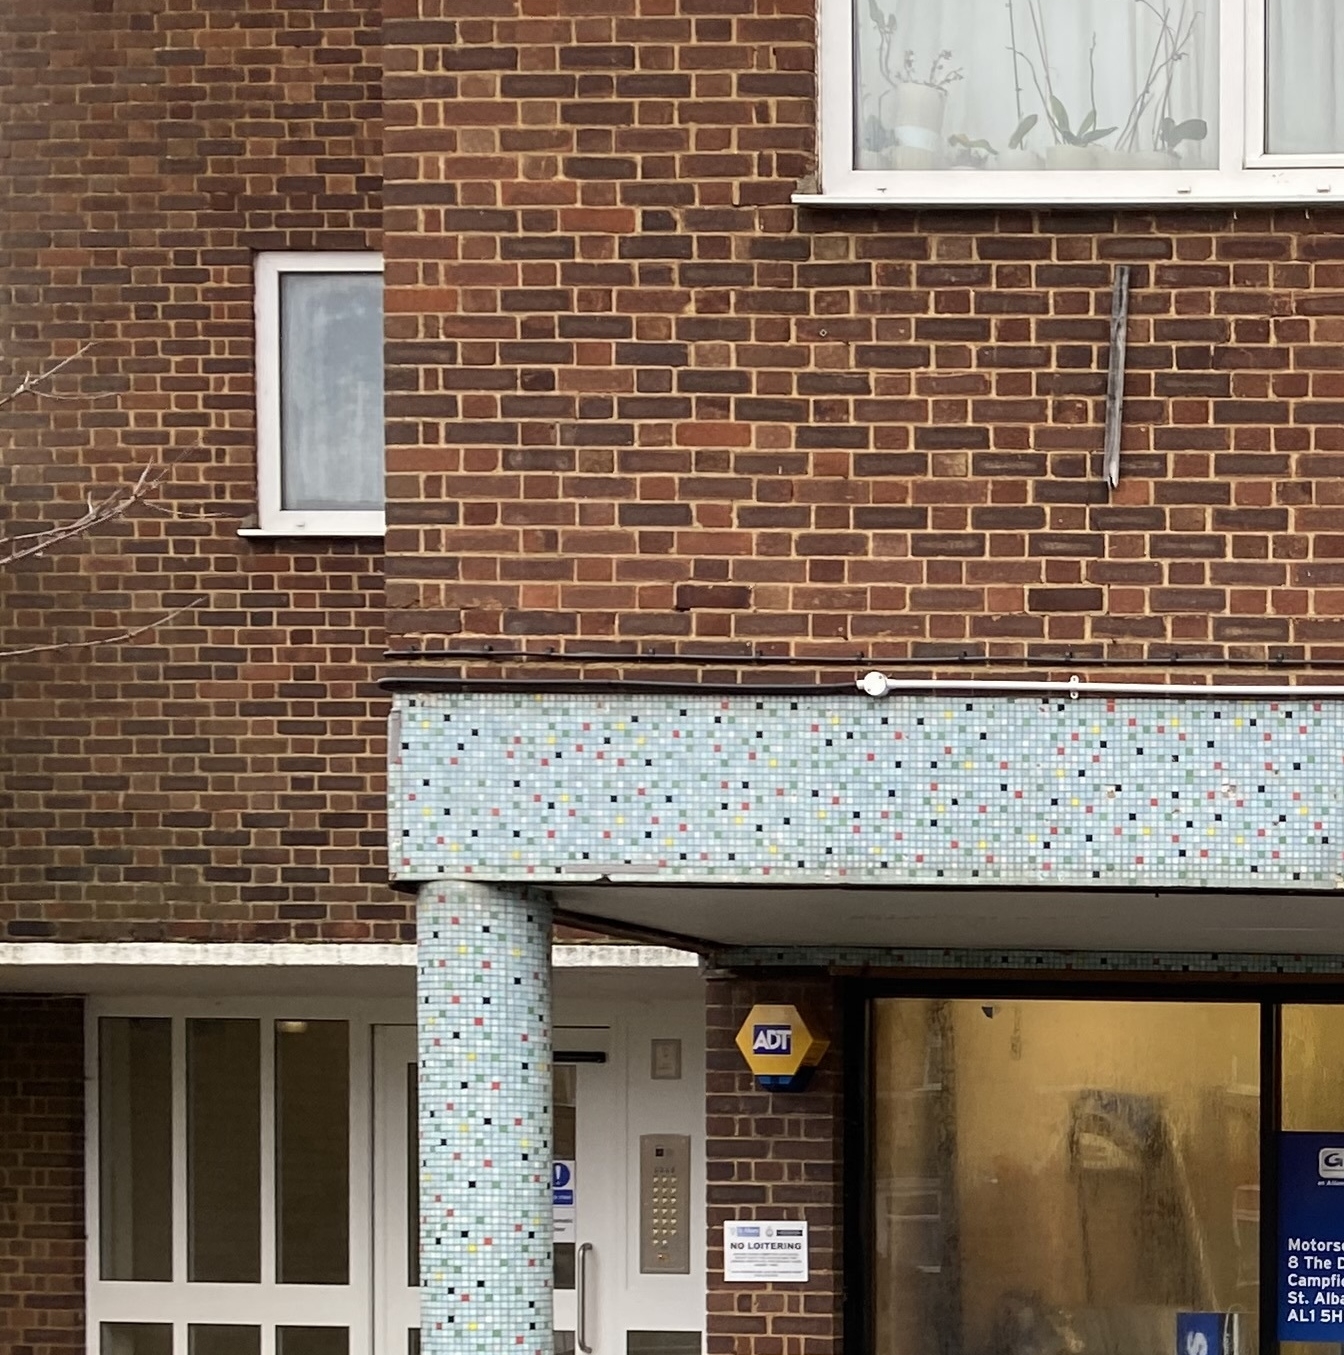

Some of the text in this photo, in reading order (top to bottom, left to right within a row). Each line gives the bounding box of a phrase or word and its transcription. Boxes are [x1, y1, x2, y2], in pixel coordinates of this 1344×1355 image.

[752, 1029, 792, 1050] ADT
[730, 1242, 802, 1250] NO LOITERING
[1287, 1256, 1299, 1269] 8
[1304, 1256, 1332, 1270] The
[1287, 1291, 1309, 1305] St.
[1287, 1309, 1315, 1322] AL1
